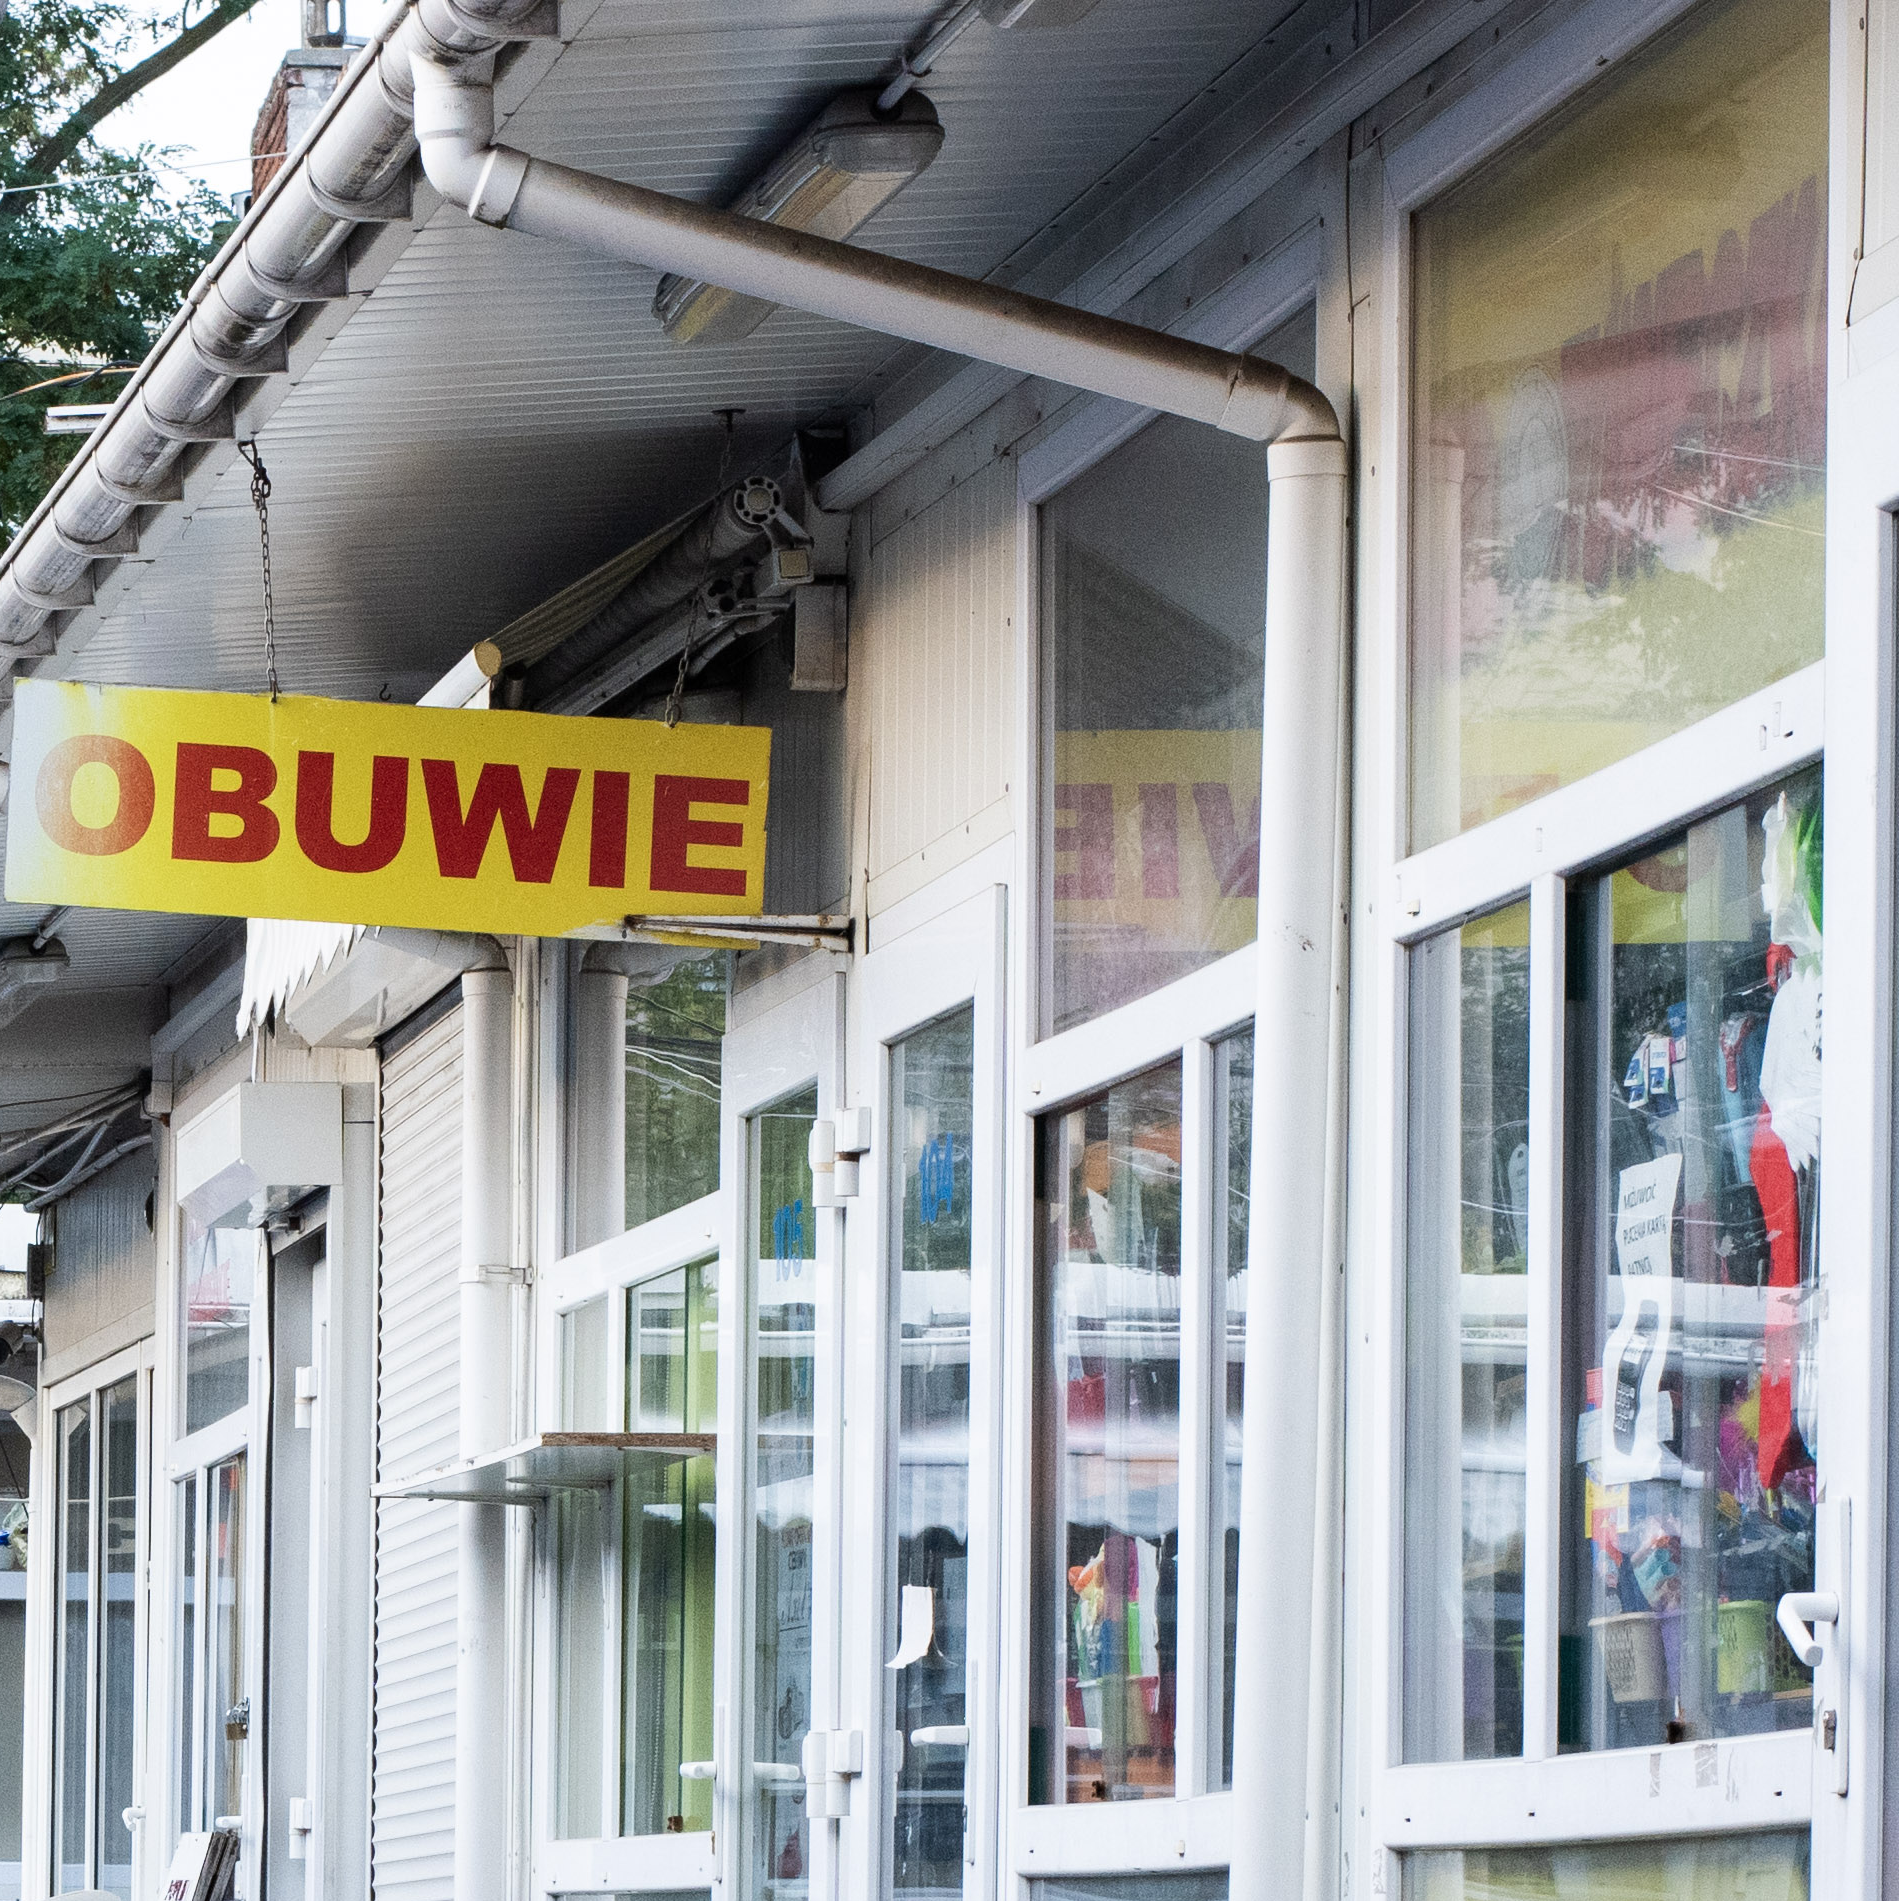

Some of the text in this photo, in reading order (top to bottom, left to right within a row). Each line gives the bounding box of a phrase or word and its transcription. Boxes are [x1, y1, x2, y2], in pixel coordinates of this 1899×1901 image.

[34, 733, 750, 898] OBUWIE
[918, 1132, 954, 1225] 104
[773, 1198, 804, 1282] 105
